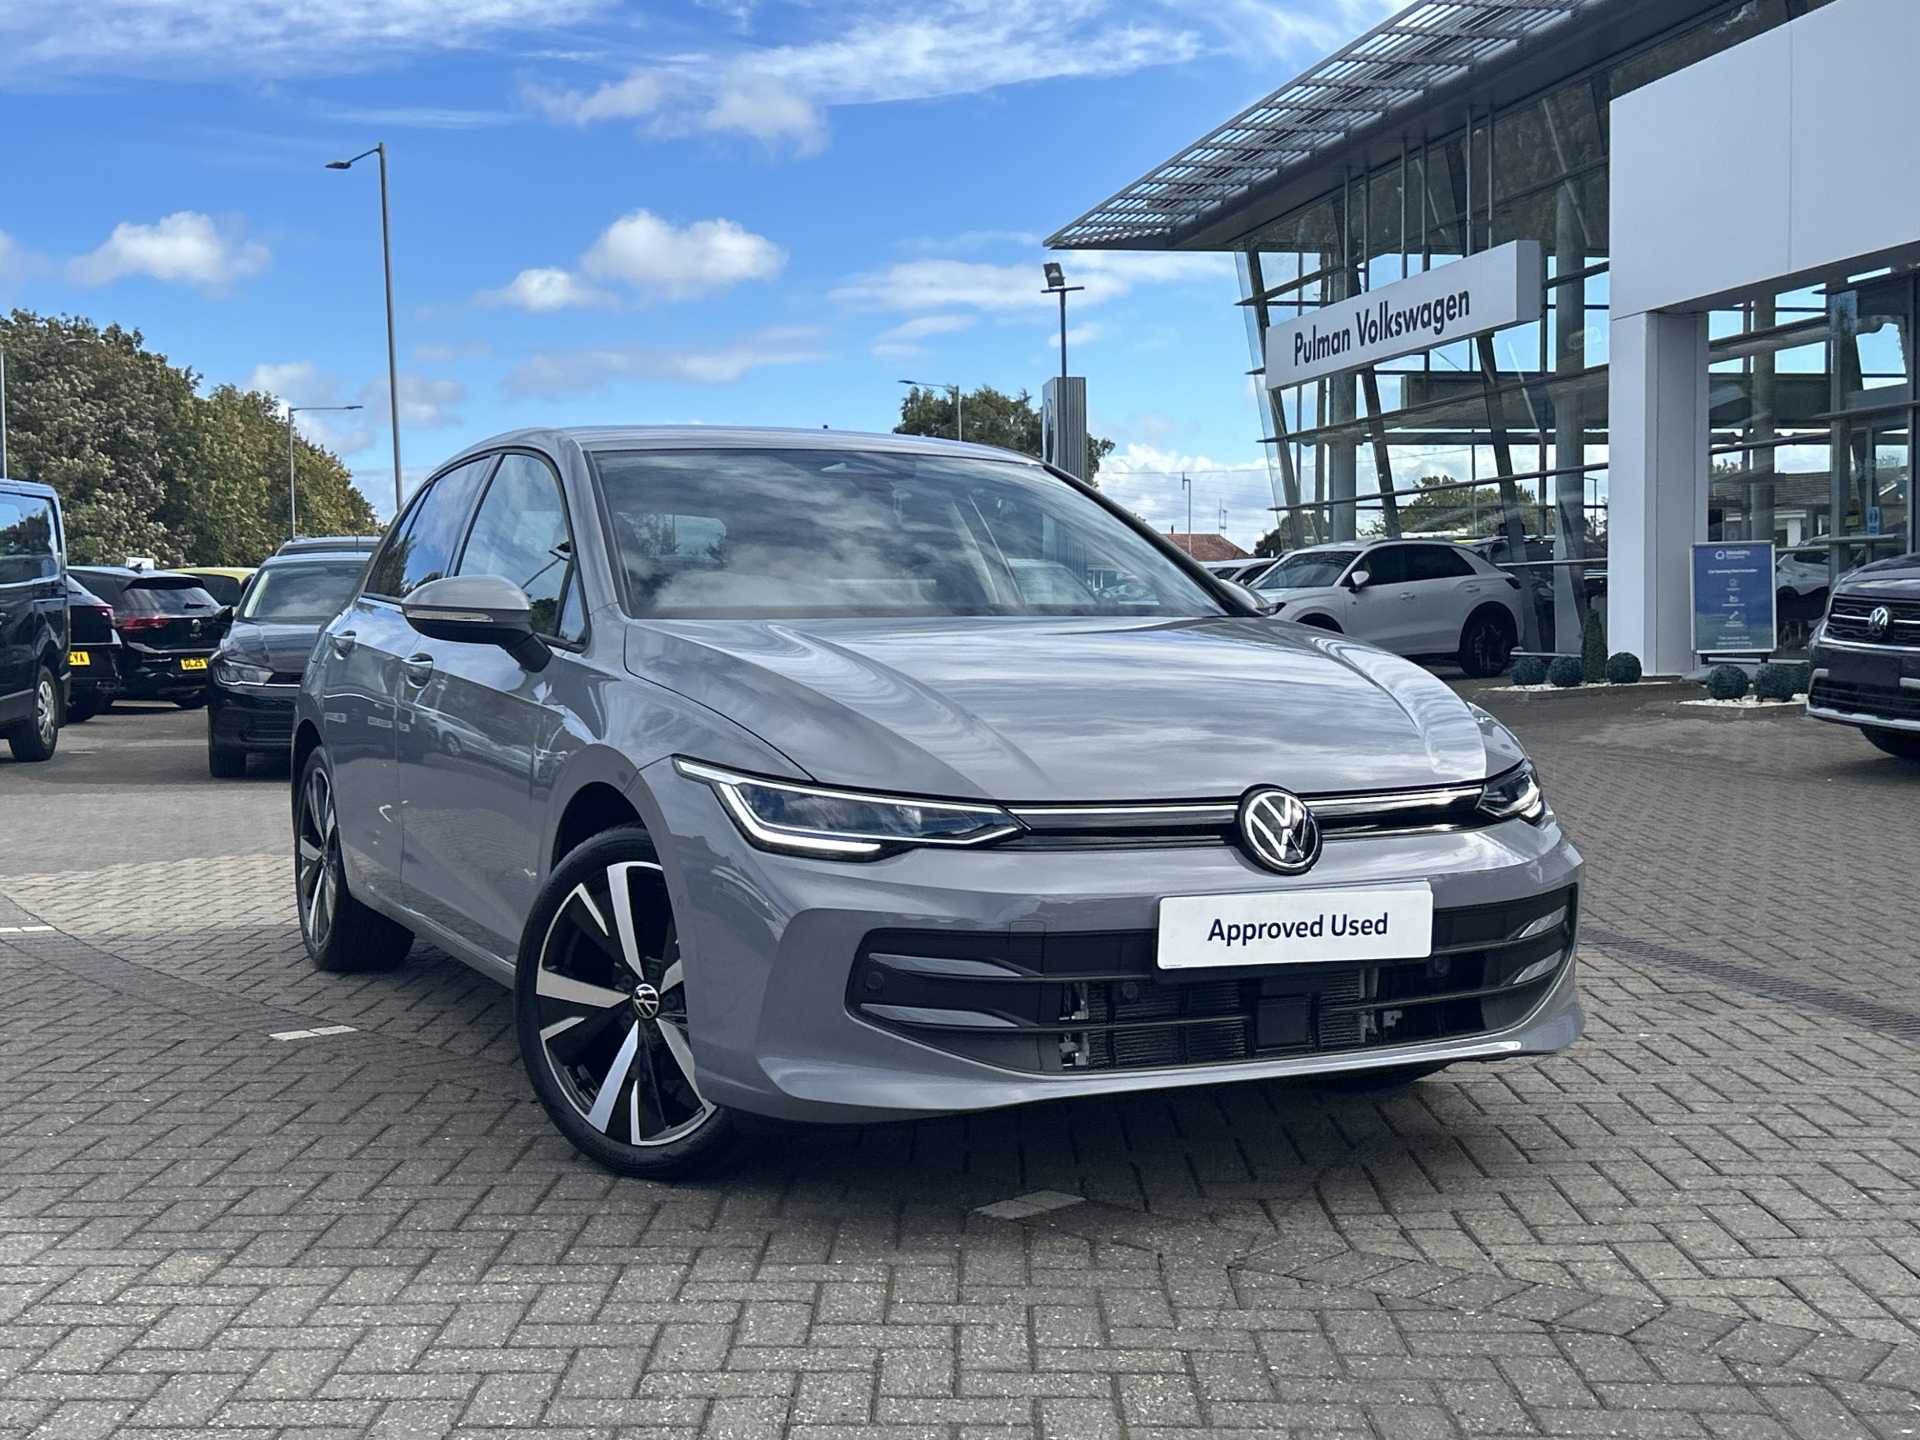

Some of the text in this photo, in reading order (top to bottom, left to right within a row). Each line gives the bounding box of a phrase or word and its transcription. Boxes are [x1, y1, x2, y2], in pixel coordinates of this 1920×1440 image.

[1294, 290, 1470, 366] Pulman Volkswagen
[1207, 912, 1388, 946] Approved Used
